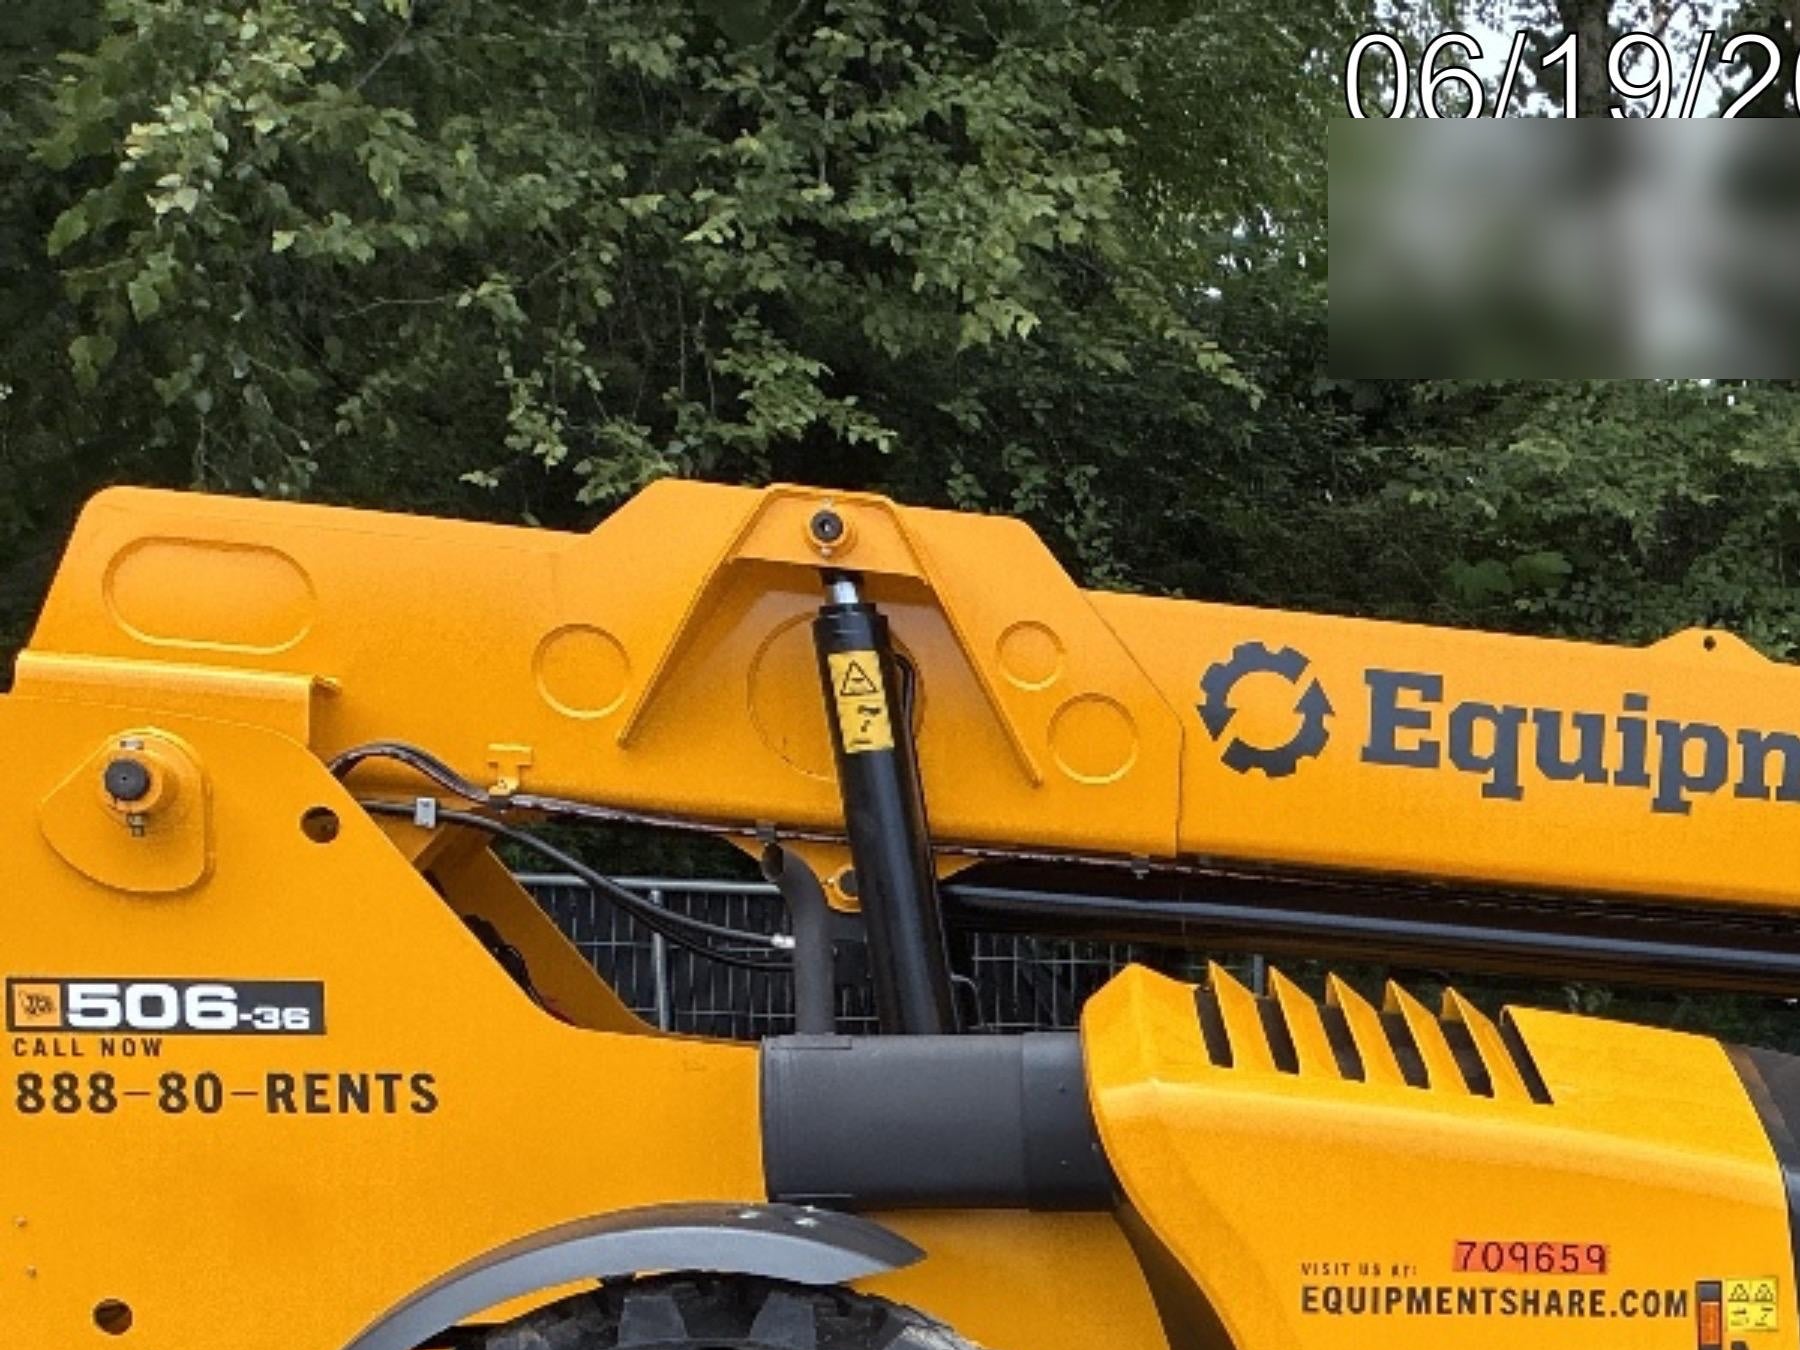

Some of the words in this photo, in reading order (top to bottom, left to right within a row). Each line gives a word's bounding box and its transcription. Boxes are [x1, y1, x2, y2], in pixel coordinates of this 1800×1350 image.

[66, 983, 311, 1031] 506-36
[13, 1037, 85, 1058] CALL
[100, 1037, 163, 1058] NOW
[16, 1071, 439, 1114] 888-80-RENTS
[1301, 1262, 1350, 1276] VISIT
[1359, 1262, 1381, 1277] US
[1457, 1241, 1607, 1274] 709659
[1301, 1285, 1689, 1317] EQUIPMENTSHARE.COM
